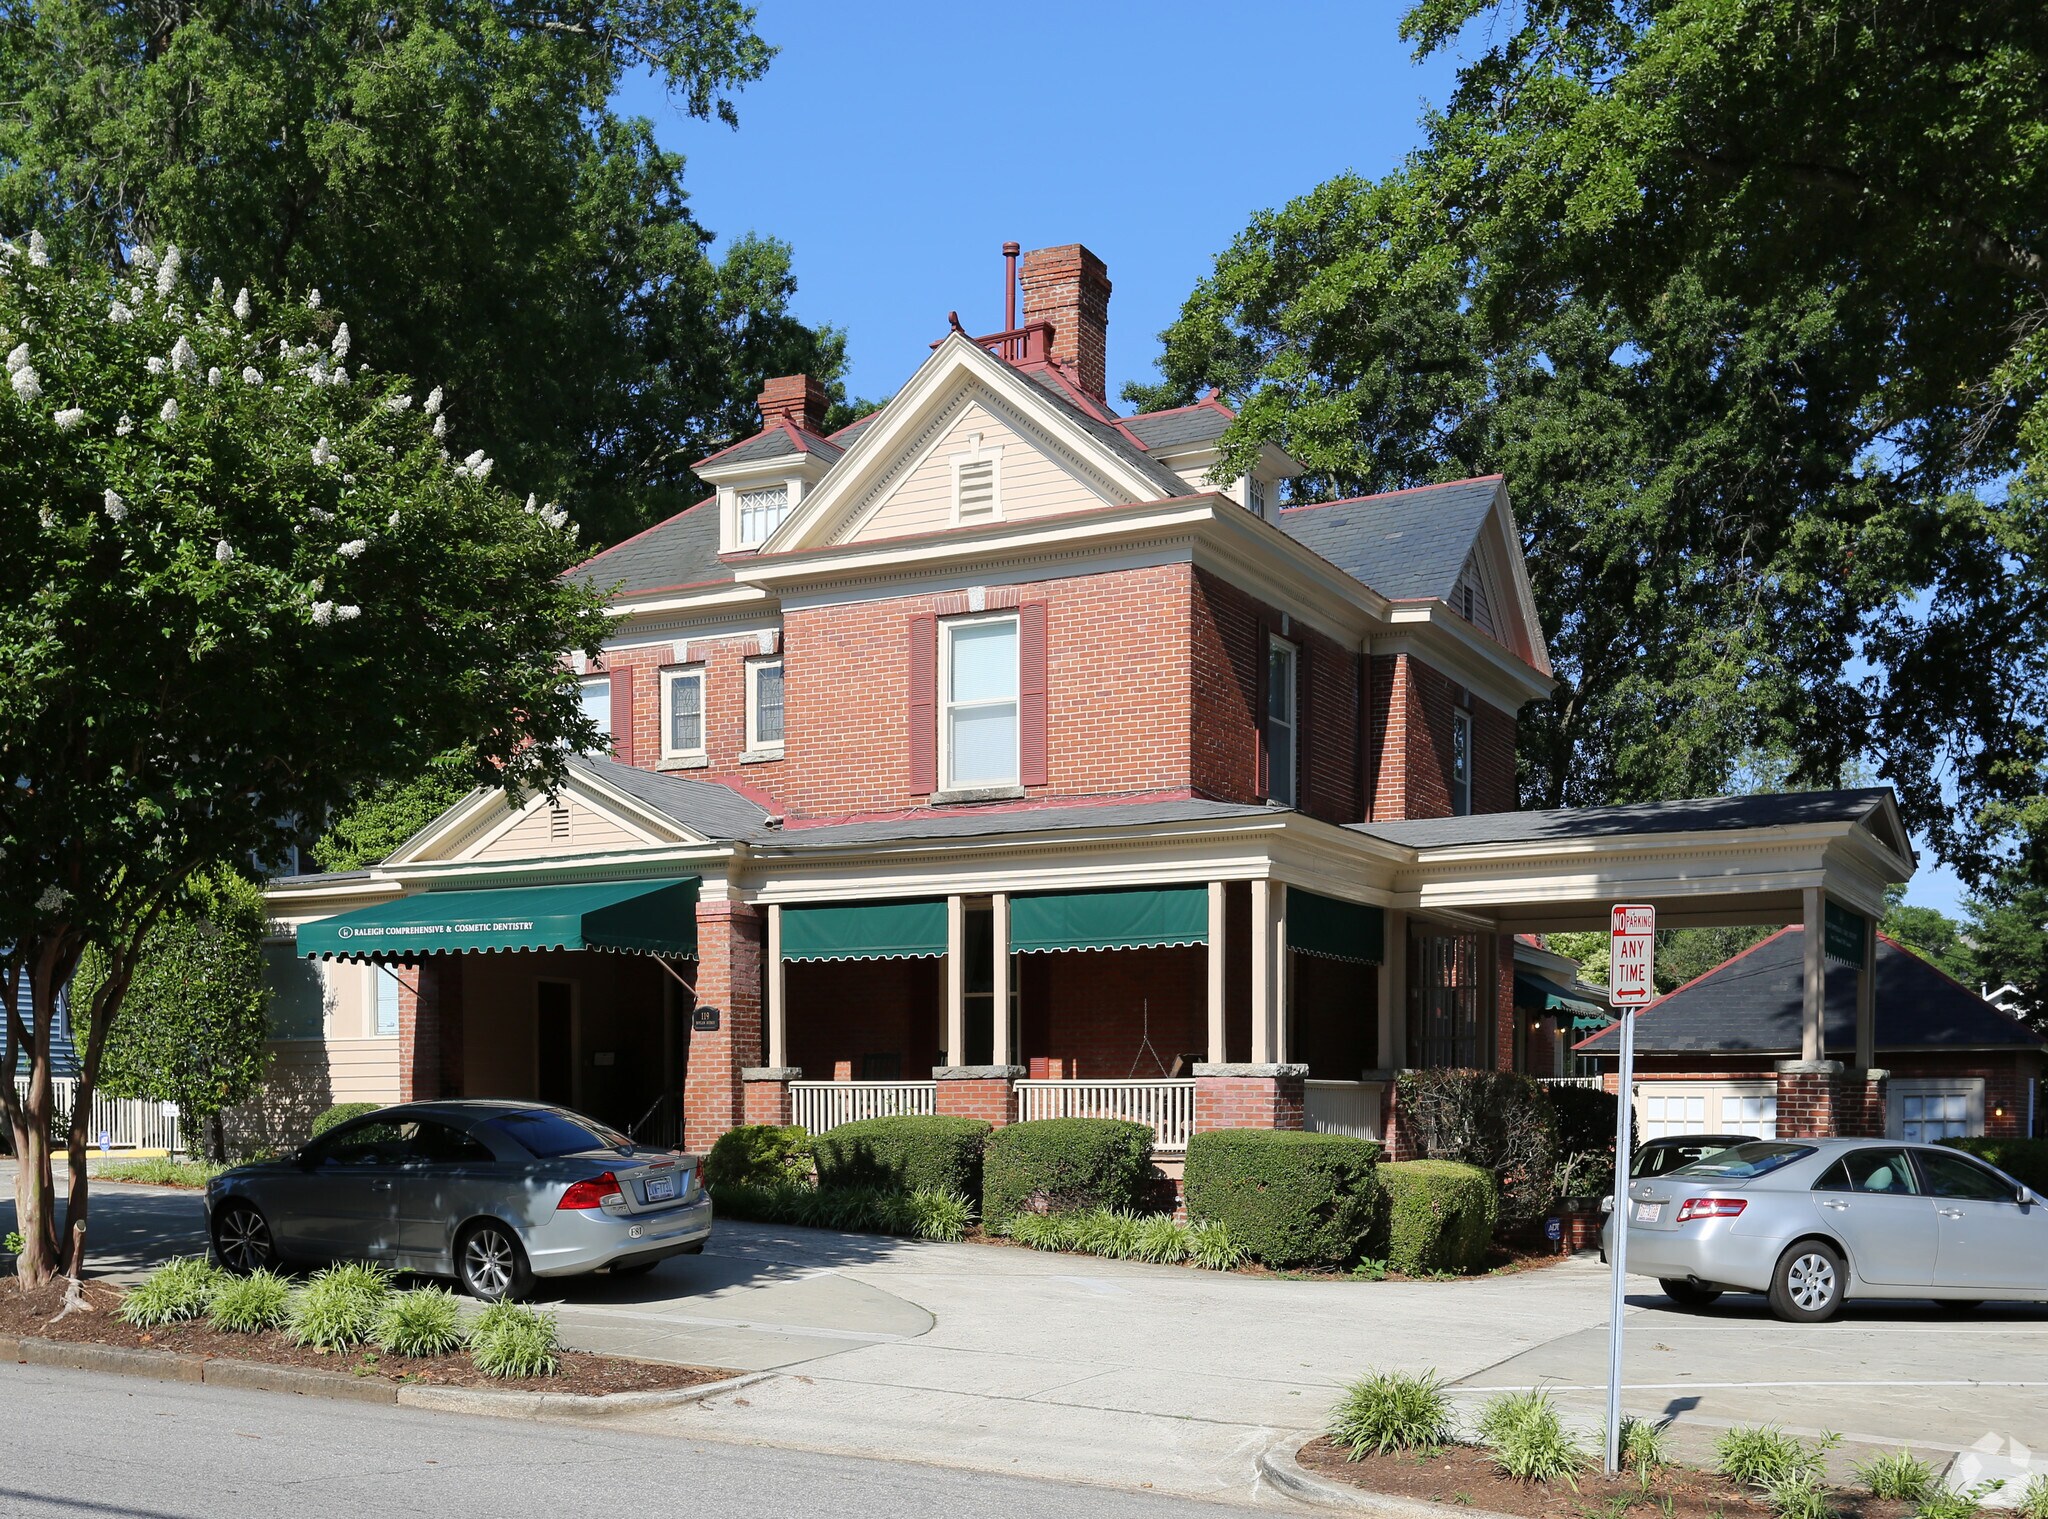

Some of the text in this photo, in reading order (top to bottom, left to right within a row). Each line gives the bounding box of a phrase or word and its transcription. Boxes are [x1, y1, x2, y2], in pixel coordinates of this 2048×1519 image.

[354, 921, 533, 936] RALEIGH COMPREHENSIVE & COSMETIC DENTISTRY
[1613, 913, 1652, 931] NO PARKING
[1621, 941, 1644, 958] ANY
[1619, 964, 1645, 982] TIME
